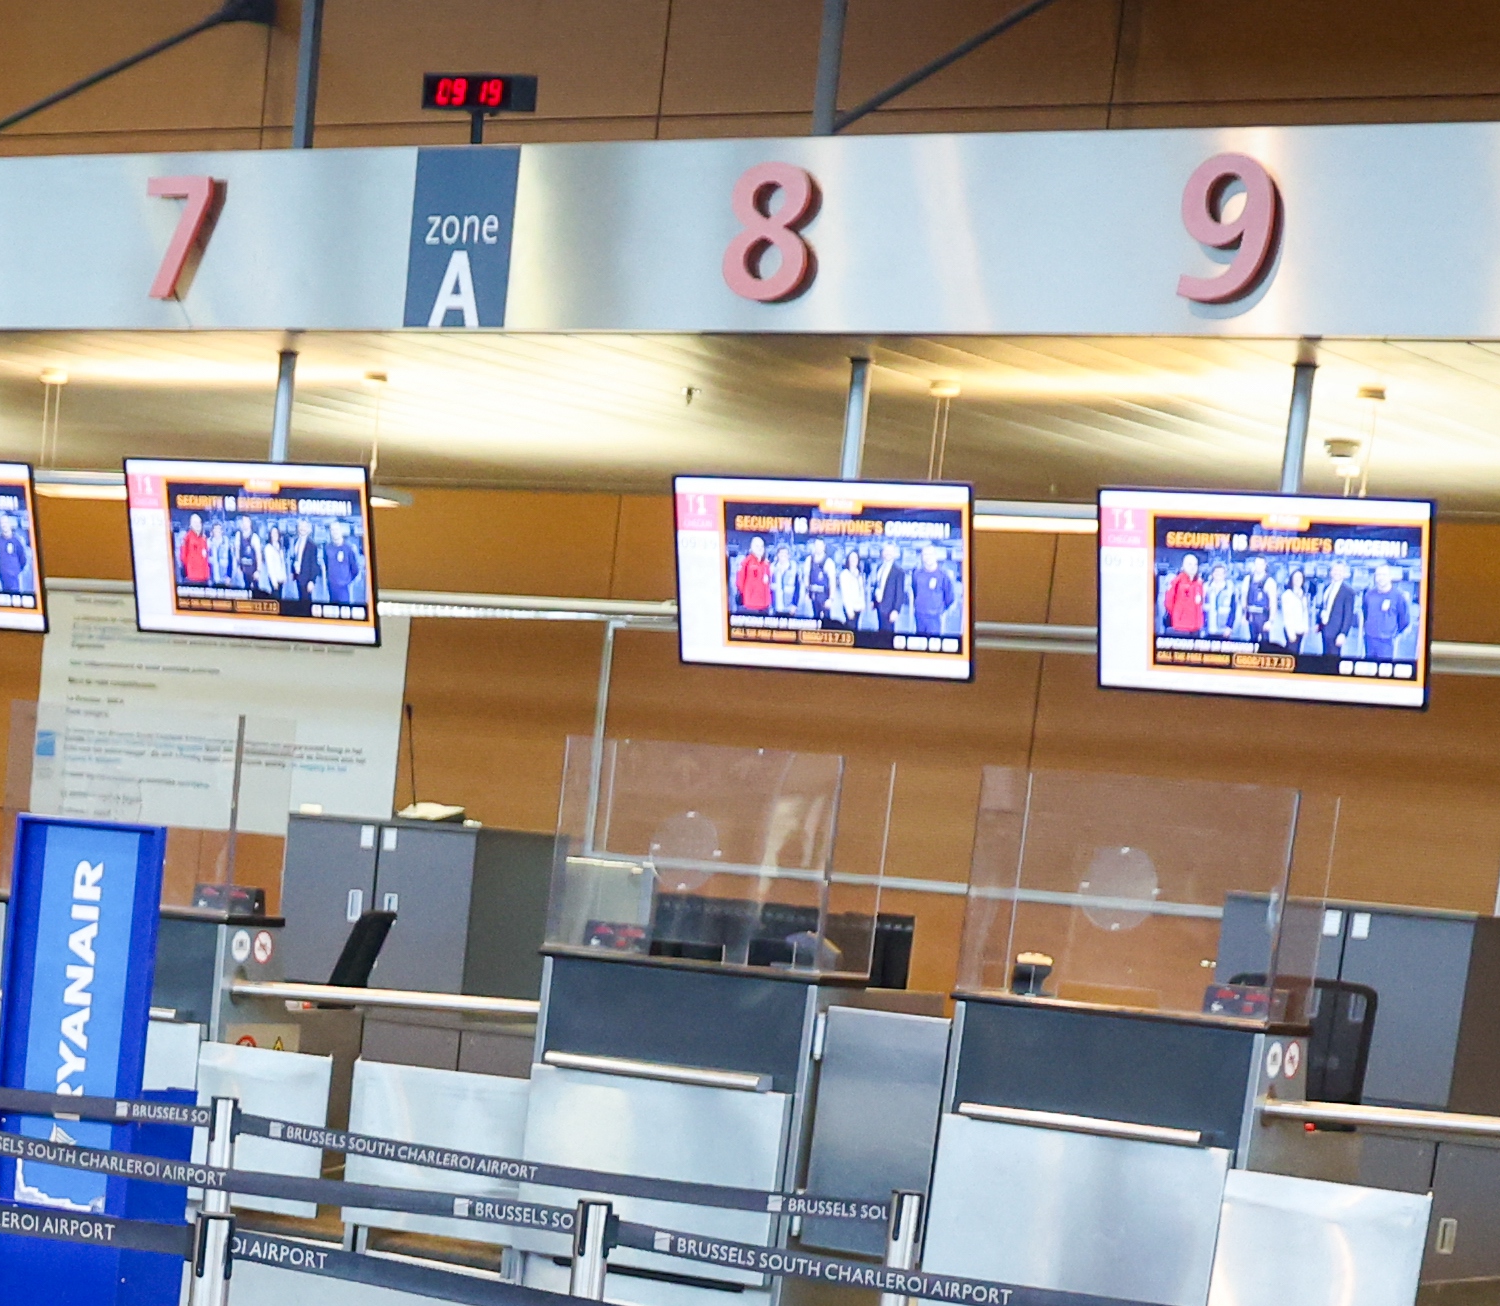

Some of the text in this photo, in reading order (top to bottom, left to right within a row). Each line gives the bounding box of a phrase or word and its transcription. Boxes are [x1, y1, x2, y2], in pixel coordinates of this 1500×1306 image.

[147, 175, 220, 299] 7
[425, 212, 499, 247] zone
[722, 161, 816, 302] 8
[1176, 151, 1280, 304] 9
[428, 250, 480, 328] A
[735, 515, 792, 534] SECURITY
[794, 517, 808, 534] IS
[1113, 509, 1135, 529] T1
[1166, 531, 1230, 551] SECURITY
[1232, 534, 1248, 551] IS
[54, 860, 104, 1121] RYANAIR
[132, 1104, 188, 1125] BRUSSELS
[27, 1141, 77, 1166] SOUTH
[79, 1149, 160, 1179] CHARLEROI
[162, 1162, 227, 1188] AIRPORT
[286, 1125, 539, 1182] BRUSSELS SOUTH CHARLEROI AIRPORT
[475, 1202, 548, 1227] BRUSSELS
[787, 1197, 856, 1219] BRUSSELS
[42, 1215, 116, 1243] AIRPORT
[251, 1240, 328, 1270] AIRPORT
[677, 1236, 1013, 1306] BRUSSELS SOUTH CHARLEROI AIRPORT
